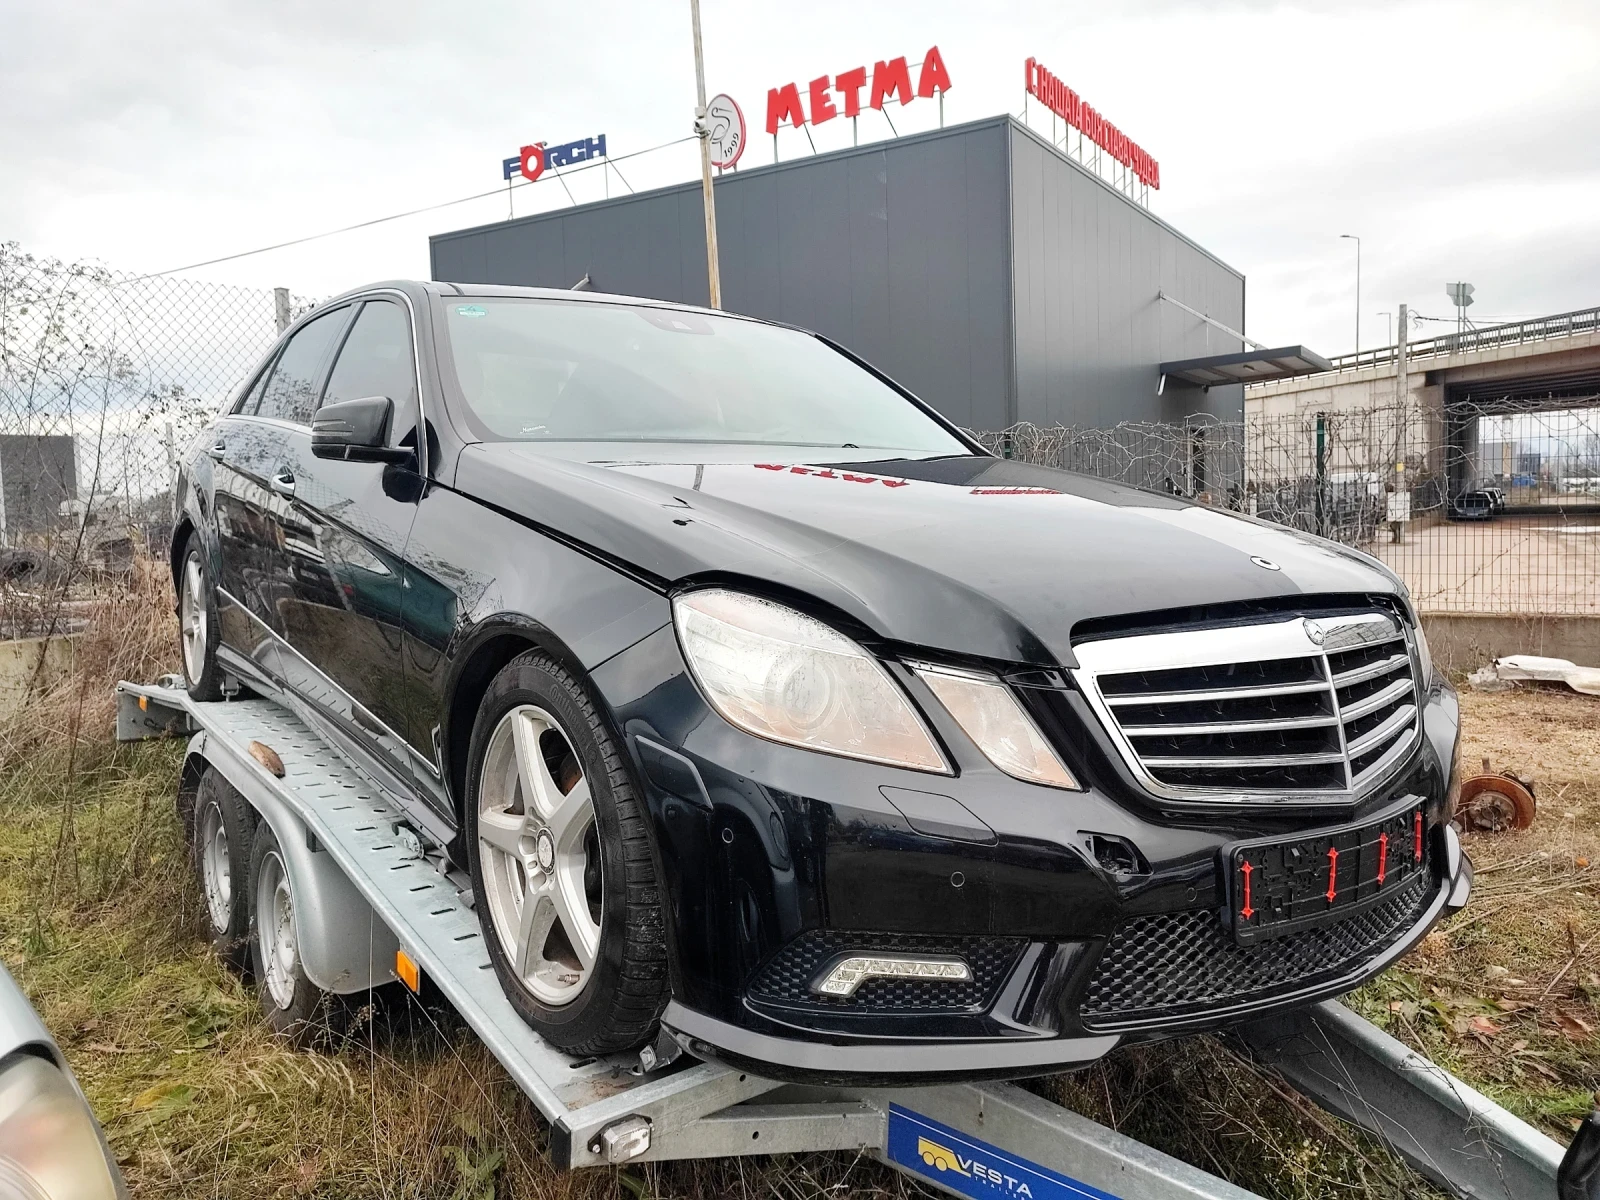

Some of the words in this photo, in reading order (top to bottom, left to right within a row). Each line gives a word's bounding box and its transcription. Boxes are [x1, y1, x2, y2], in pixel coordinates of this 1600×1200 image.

[1025, 56, 1037, 94] С
[1037, 64, 1081, 130] НАШАТА
[1081, 101, 1102, 146] БОЯ
[1102, 119, 1131, 168] СТАВАТ
[723, 132, 739, 158] 1999
[957, 1154, 1033, 1199] VESTA
